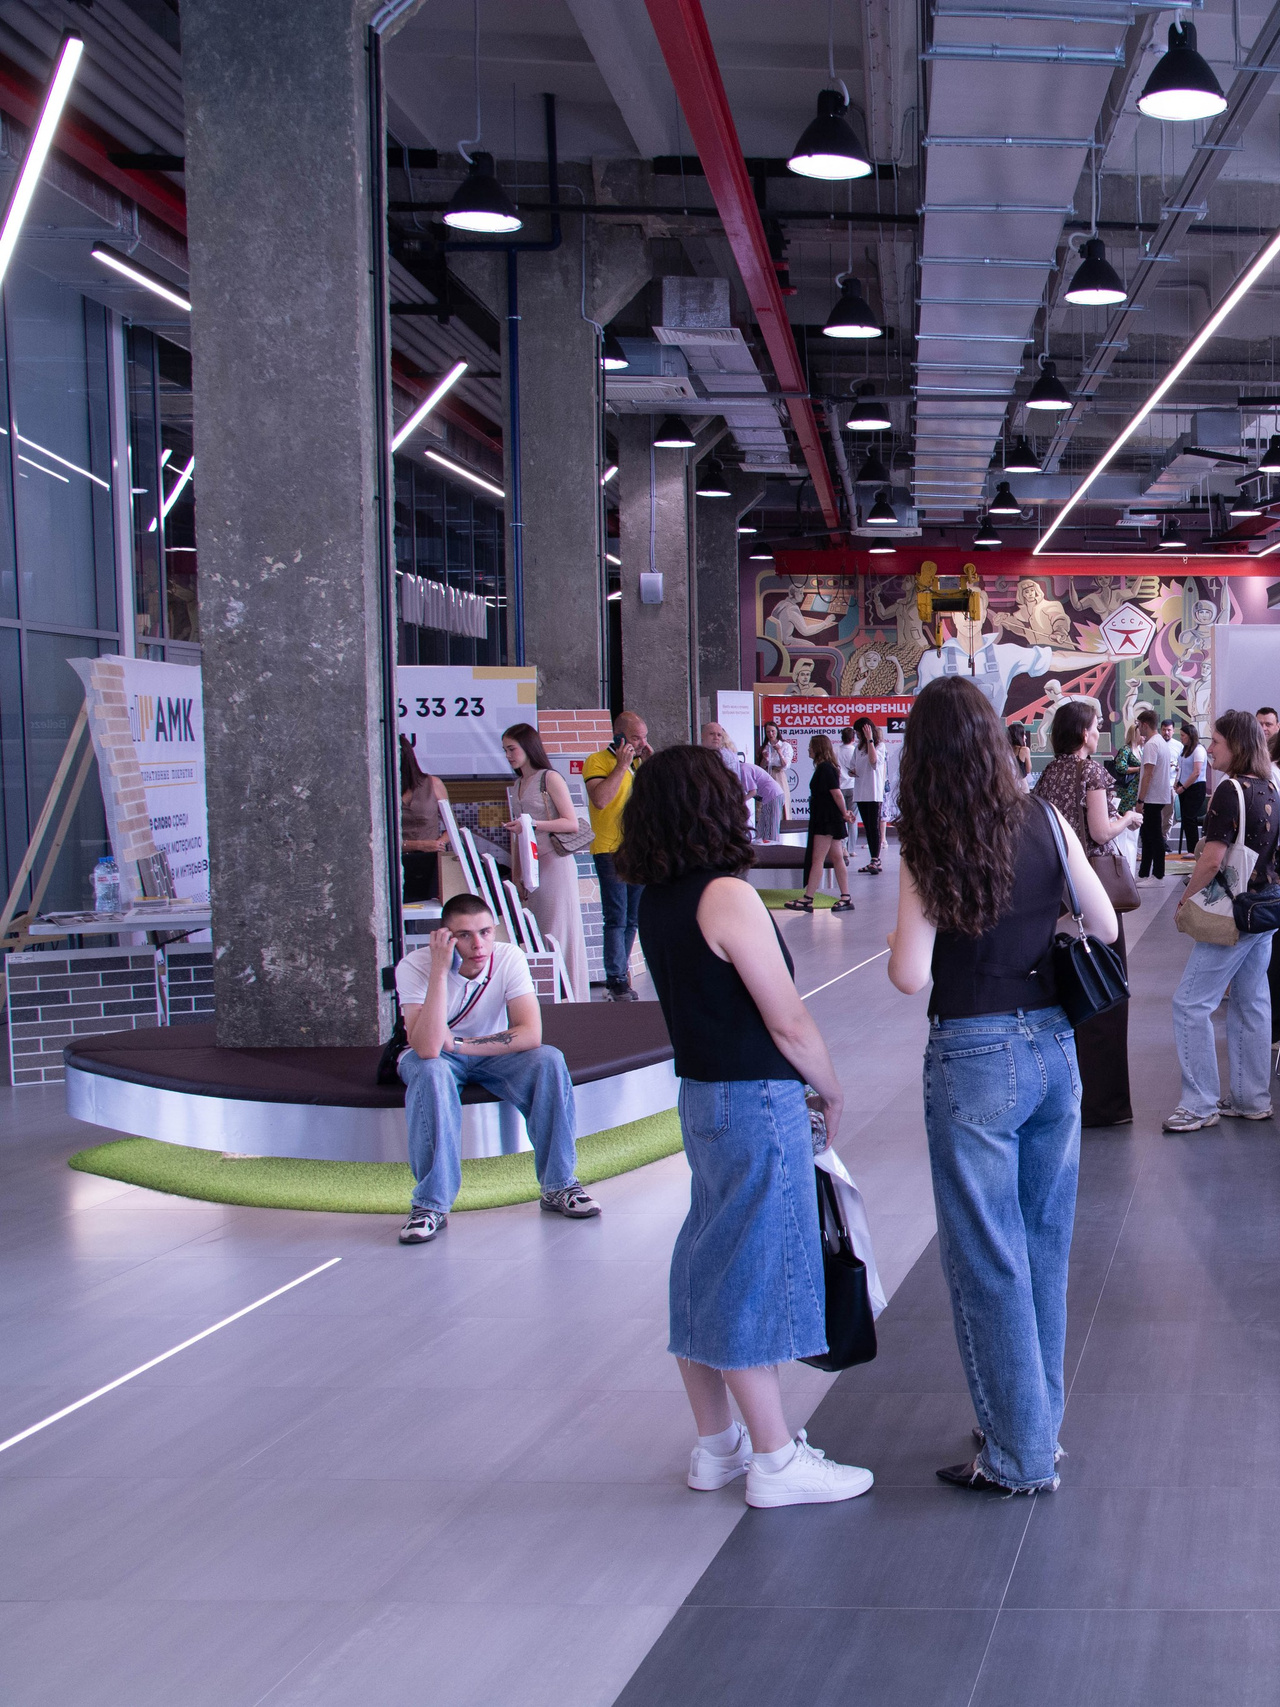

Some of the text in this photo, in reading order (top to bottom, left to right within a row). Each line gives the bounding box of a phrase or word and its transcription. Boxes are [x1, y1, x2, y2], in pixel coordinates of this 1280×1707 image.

[416, 698, 446, 717] 33
[454, 697, 485, 717] 23
[155, 696, 196, 742] АМК
[785, 716, 850, 726] САРАТОВЕ
[789, 728, 836, 736] ДИЗАЙНЕРОВ
